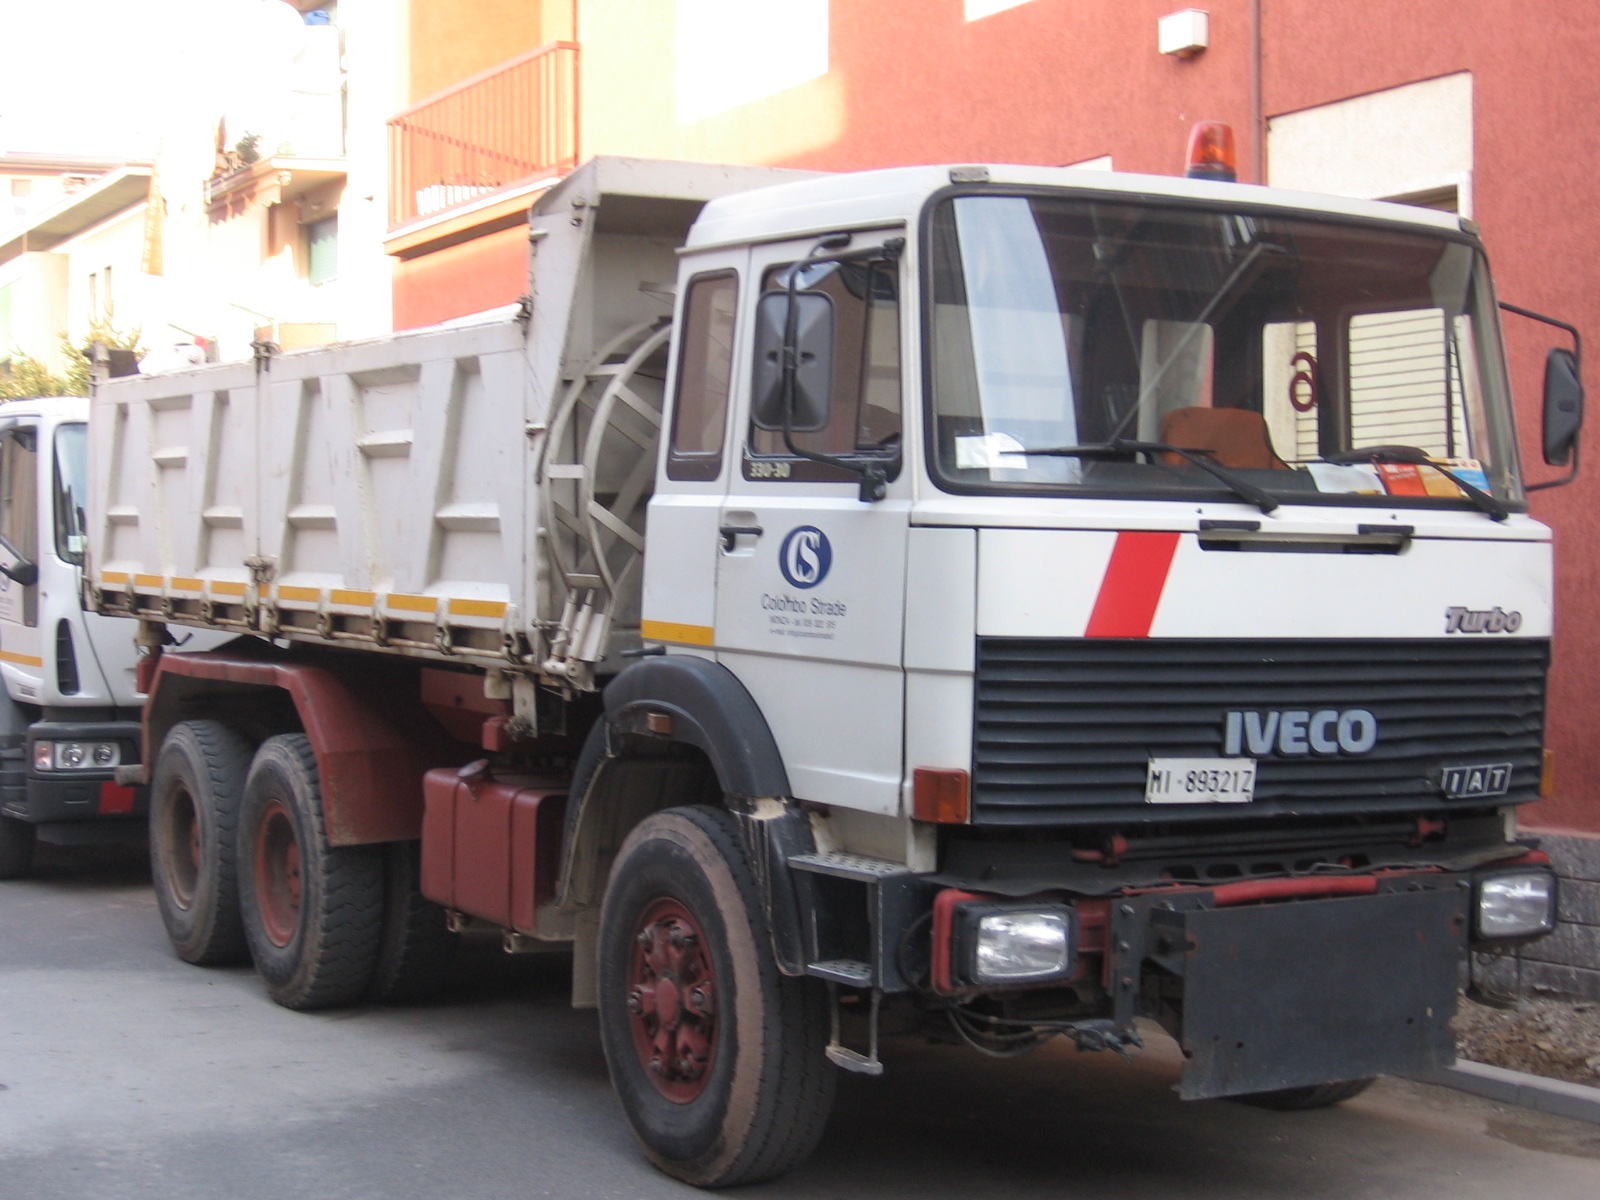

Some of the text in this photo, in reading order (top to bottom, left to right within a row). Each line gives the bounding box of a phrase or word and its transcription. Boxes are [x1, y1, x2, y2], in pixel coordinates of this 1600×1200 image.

[760, 592, 848, 617] Colombo Strade
[1444, 605, 1523, 634] Turbo
[1223, 708, 1379, 757] IVECO
